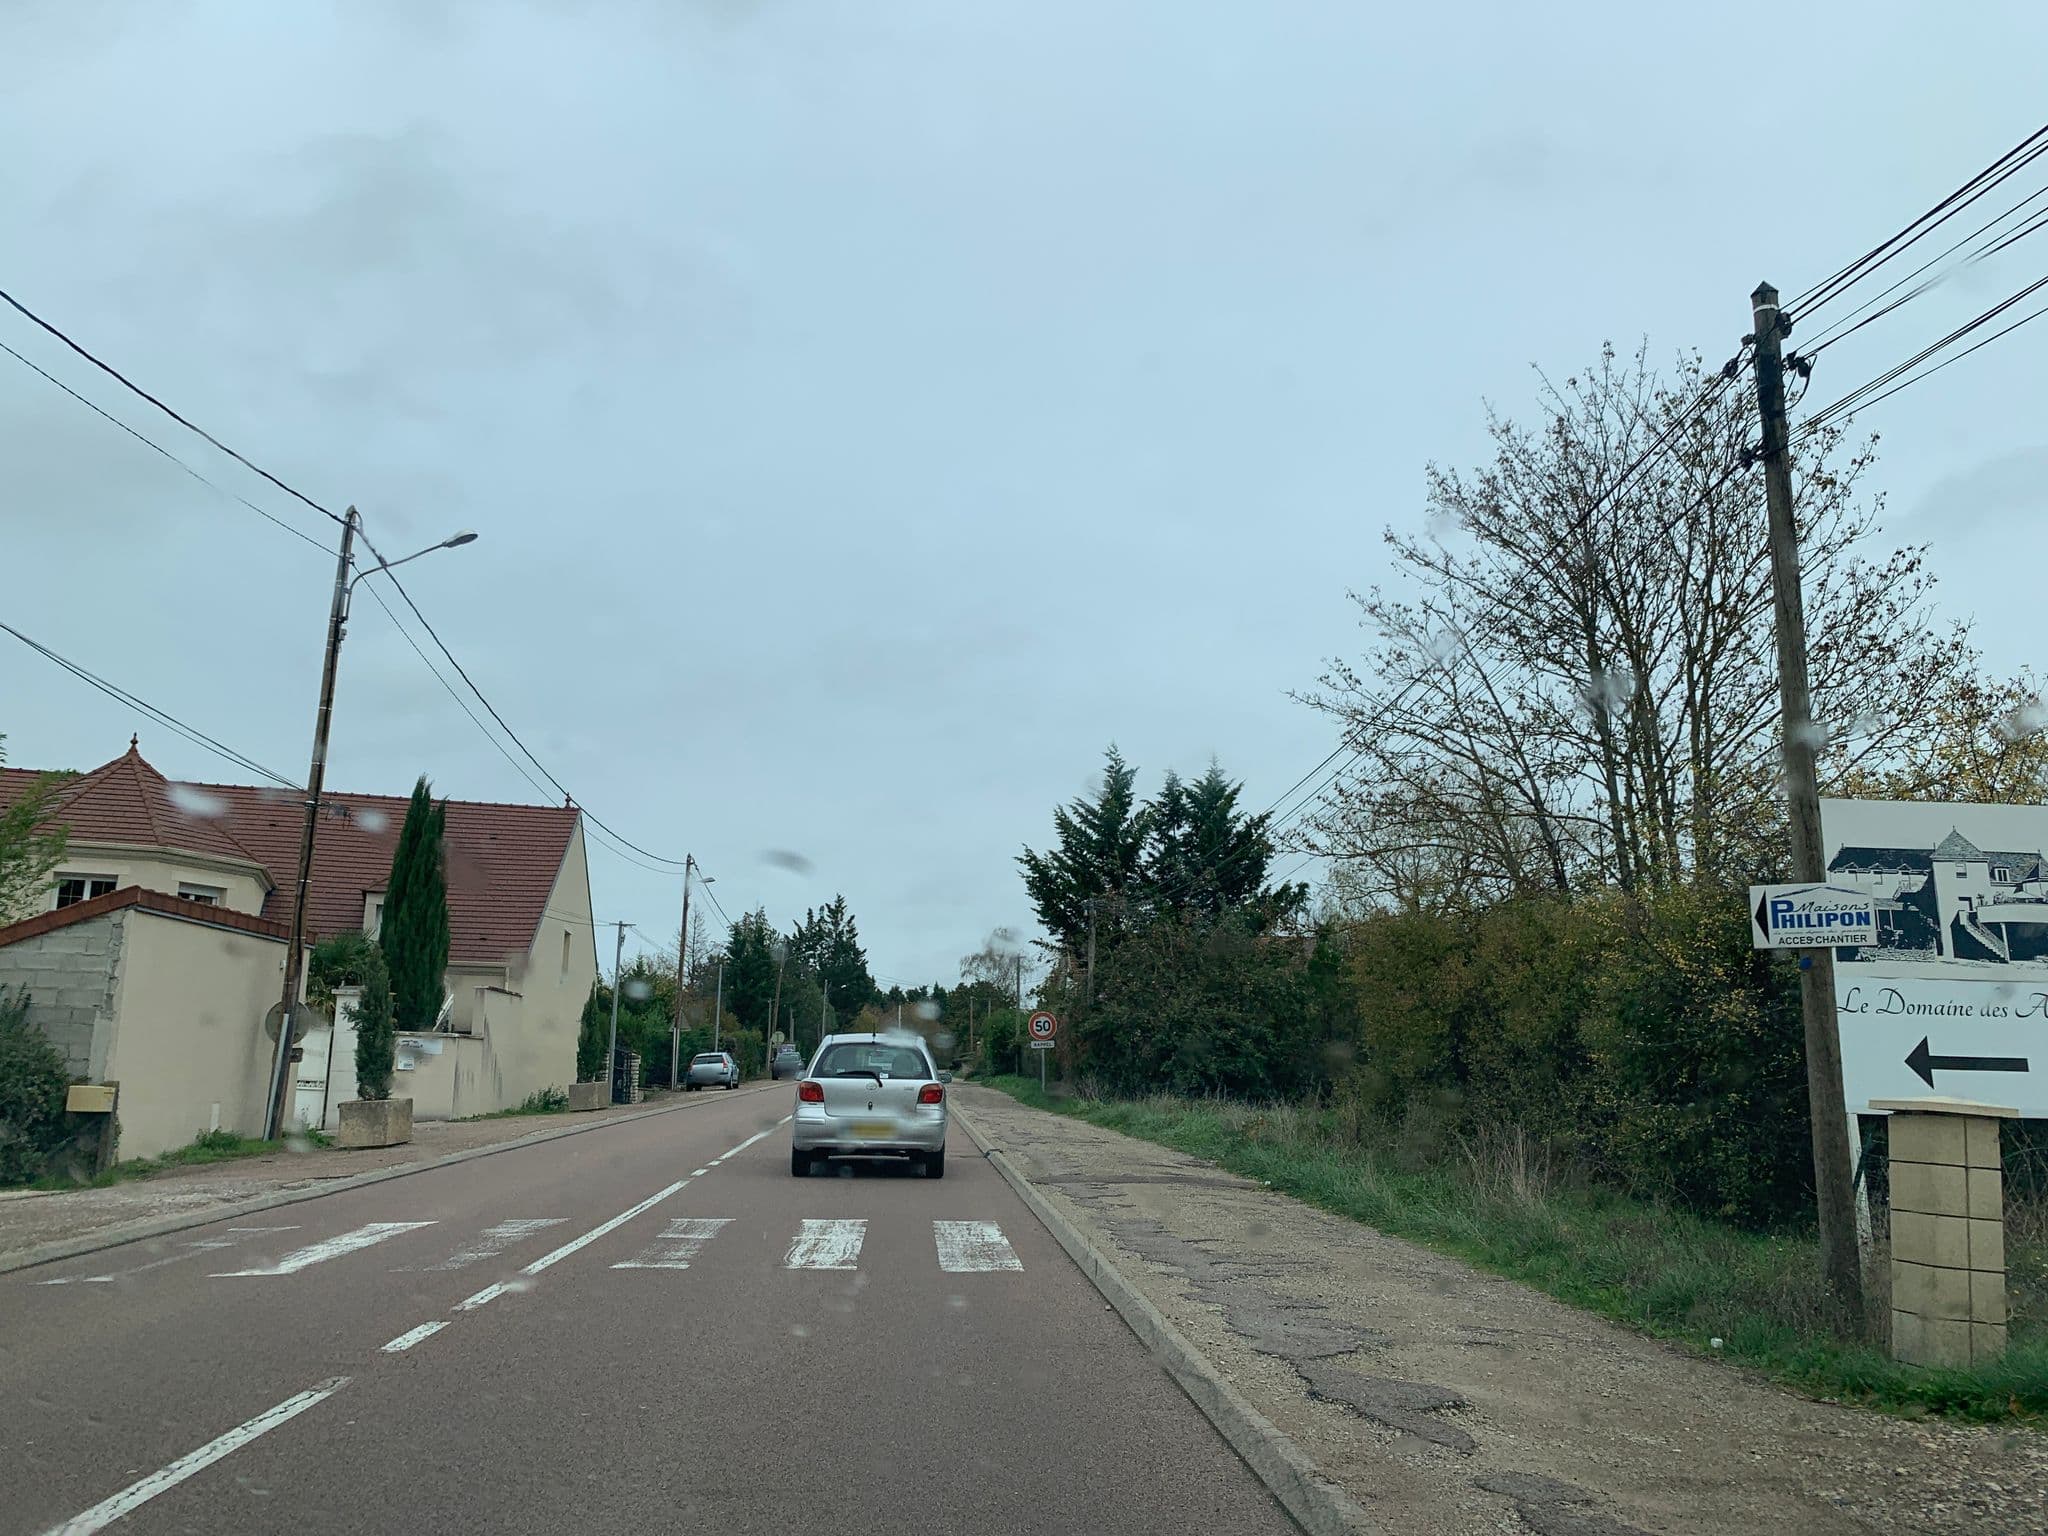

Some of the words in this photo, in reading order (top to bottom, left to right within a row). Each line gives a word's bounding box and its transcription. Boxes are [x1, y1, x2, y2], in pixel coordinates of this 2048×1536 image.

[1793, 900, 1869, 913] Maisons
[1770, 900, 1871, 929] PHILIPON
[1779, 936, 1813, 945] ACCES
[1815, 934, 1868, 944] CHANTIER
[1836, 987, 1869, 1014] Le
[1876, 987, 1973, 1017] Domaine
[1980, 989, 2009, 1018] des
[1035, 1020, 1051, 1032] 50
